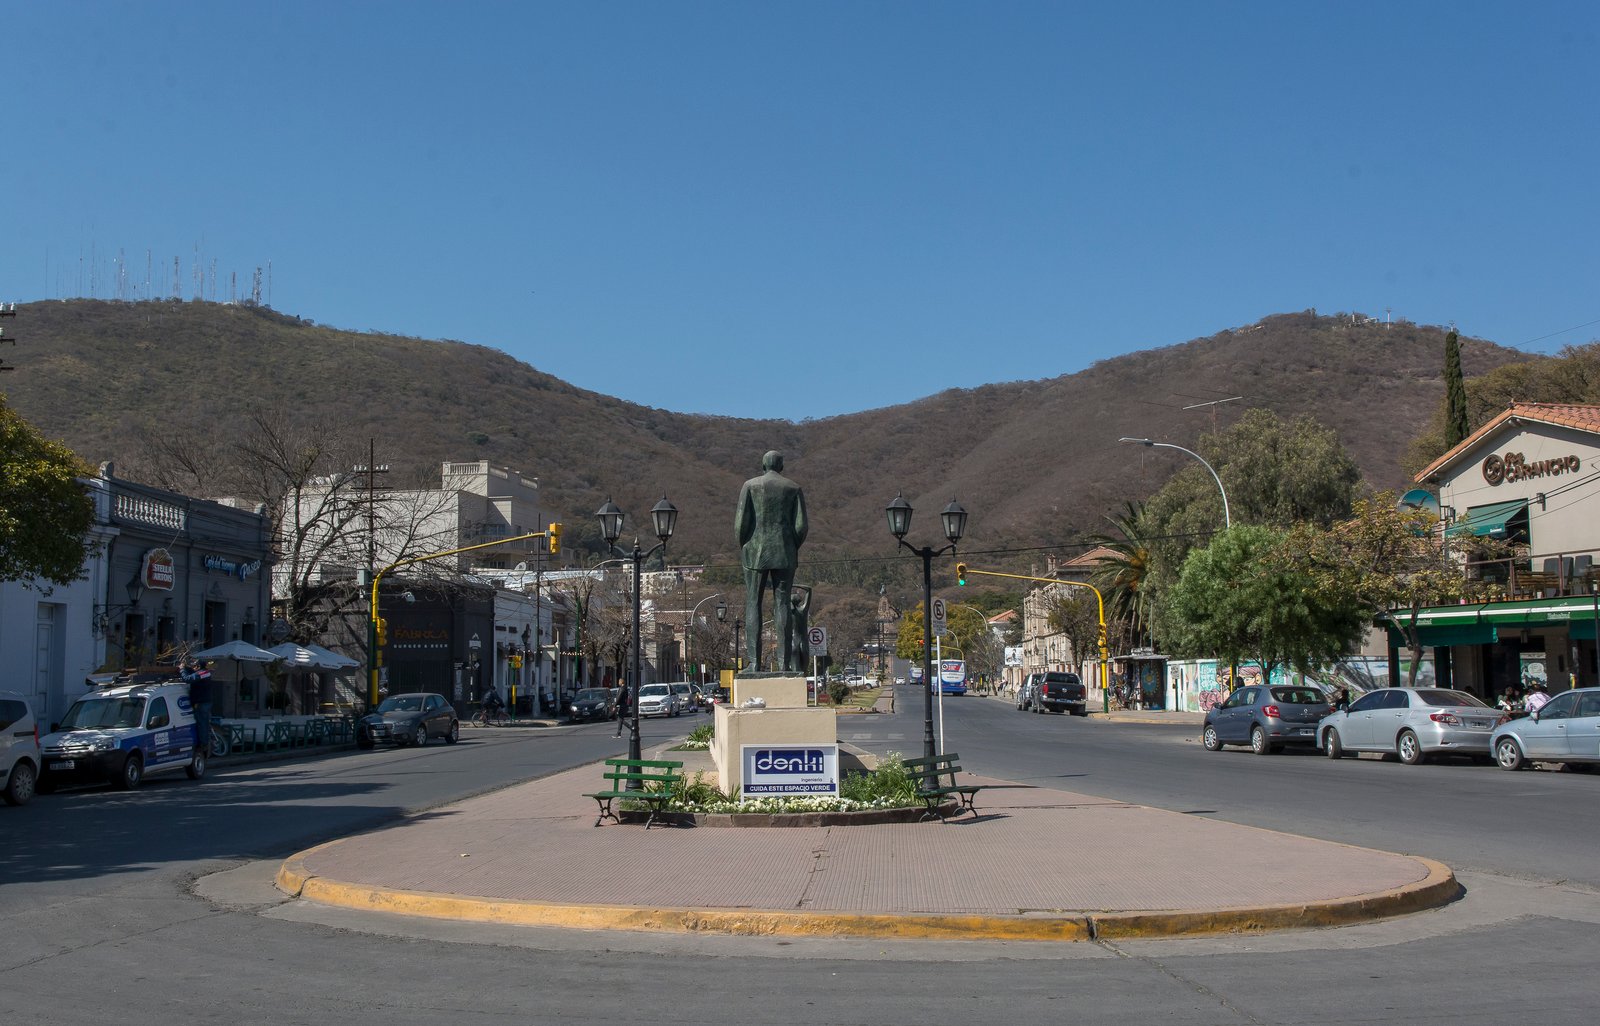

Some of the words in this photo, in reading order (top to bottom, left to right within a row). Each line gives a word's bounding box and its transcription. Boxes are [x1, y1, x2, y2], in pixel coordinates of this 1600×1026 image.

[1504, 455, 1581, 483] CARANCHO
[152, 563, 172, 573] STELLA
[240, 560, 261, 580] Paseo
[152, 572, 173, 582] ARTOIS
[757, 749, 823, 771] denki
[784, 784, 810, 792] ESPACIO
